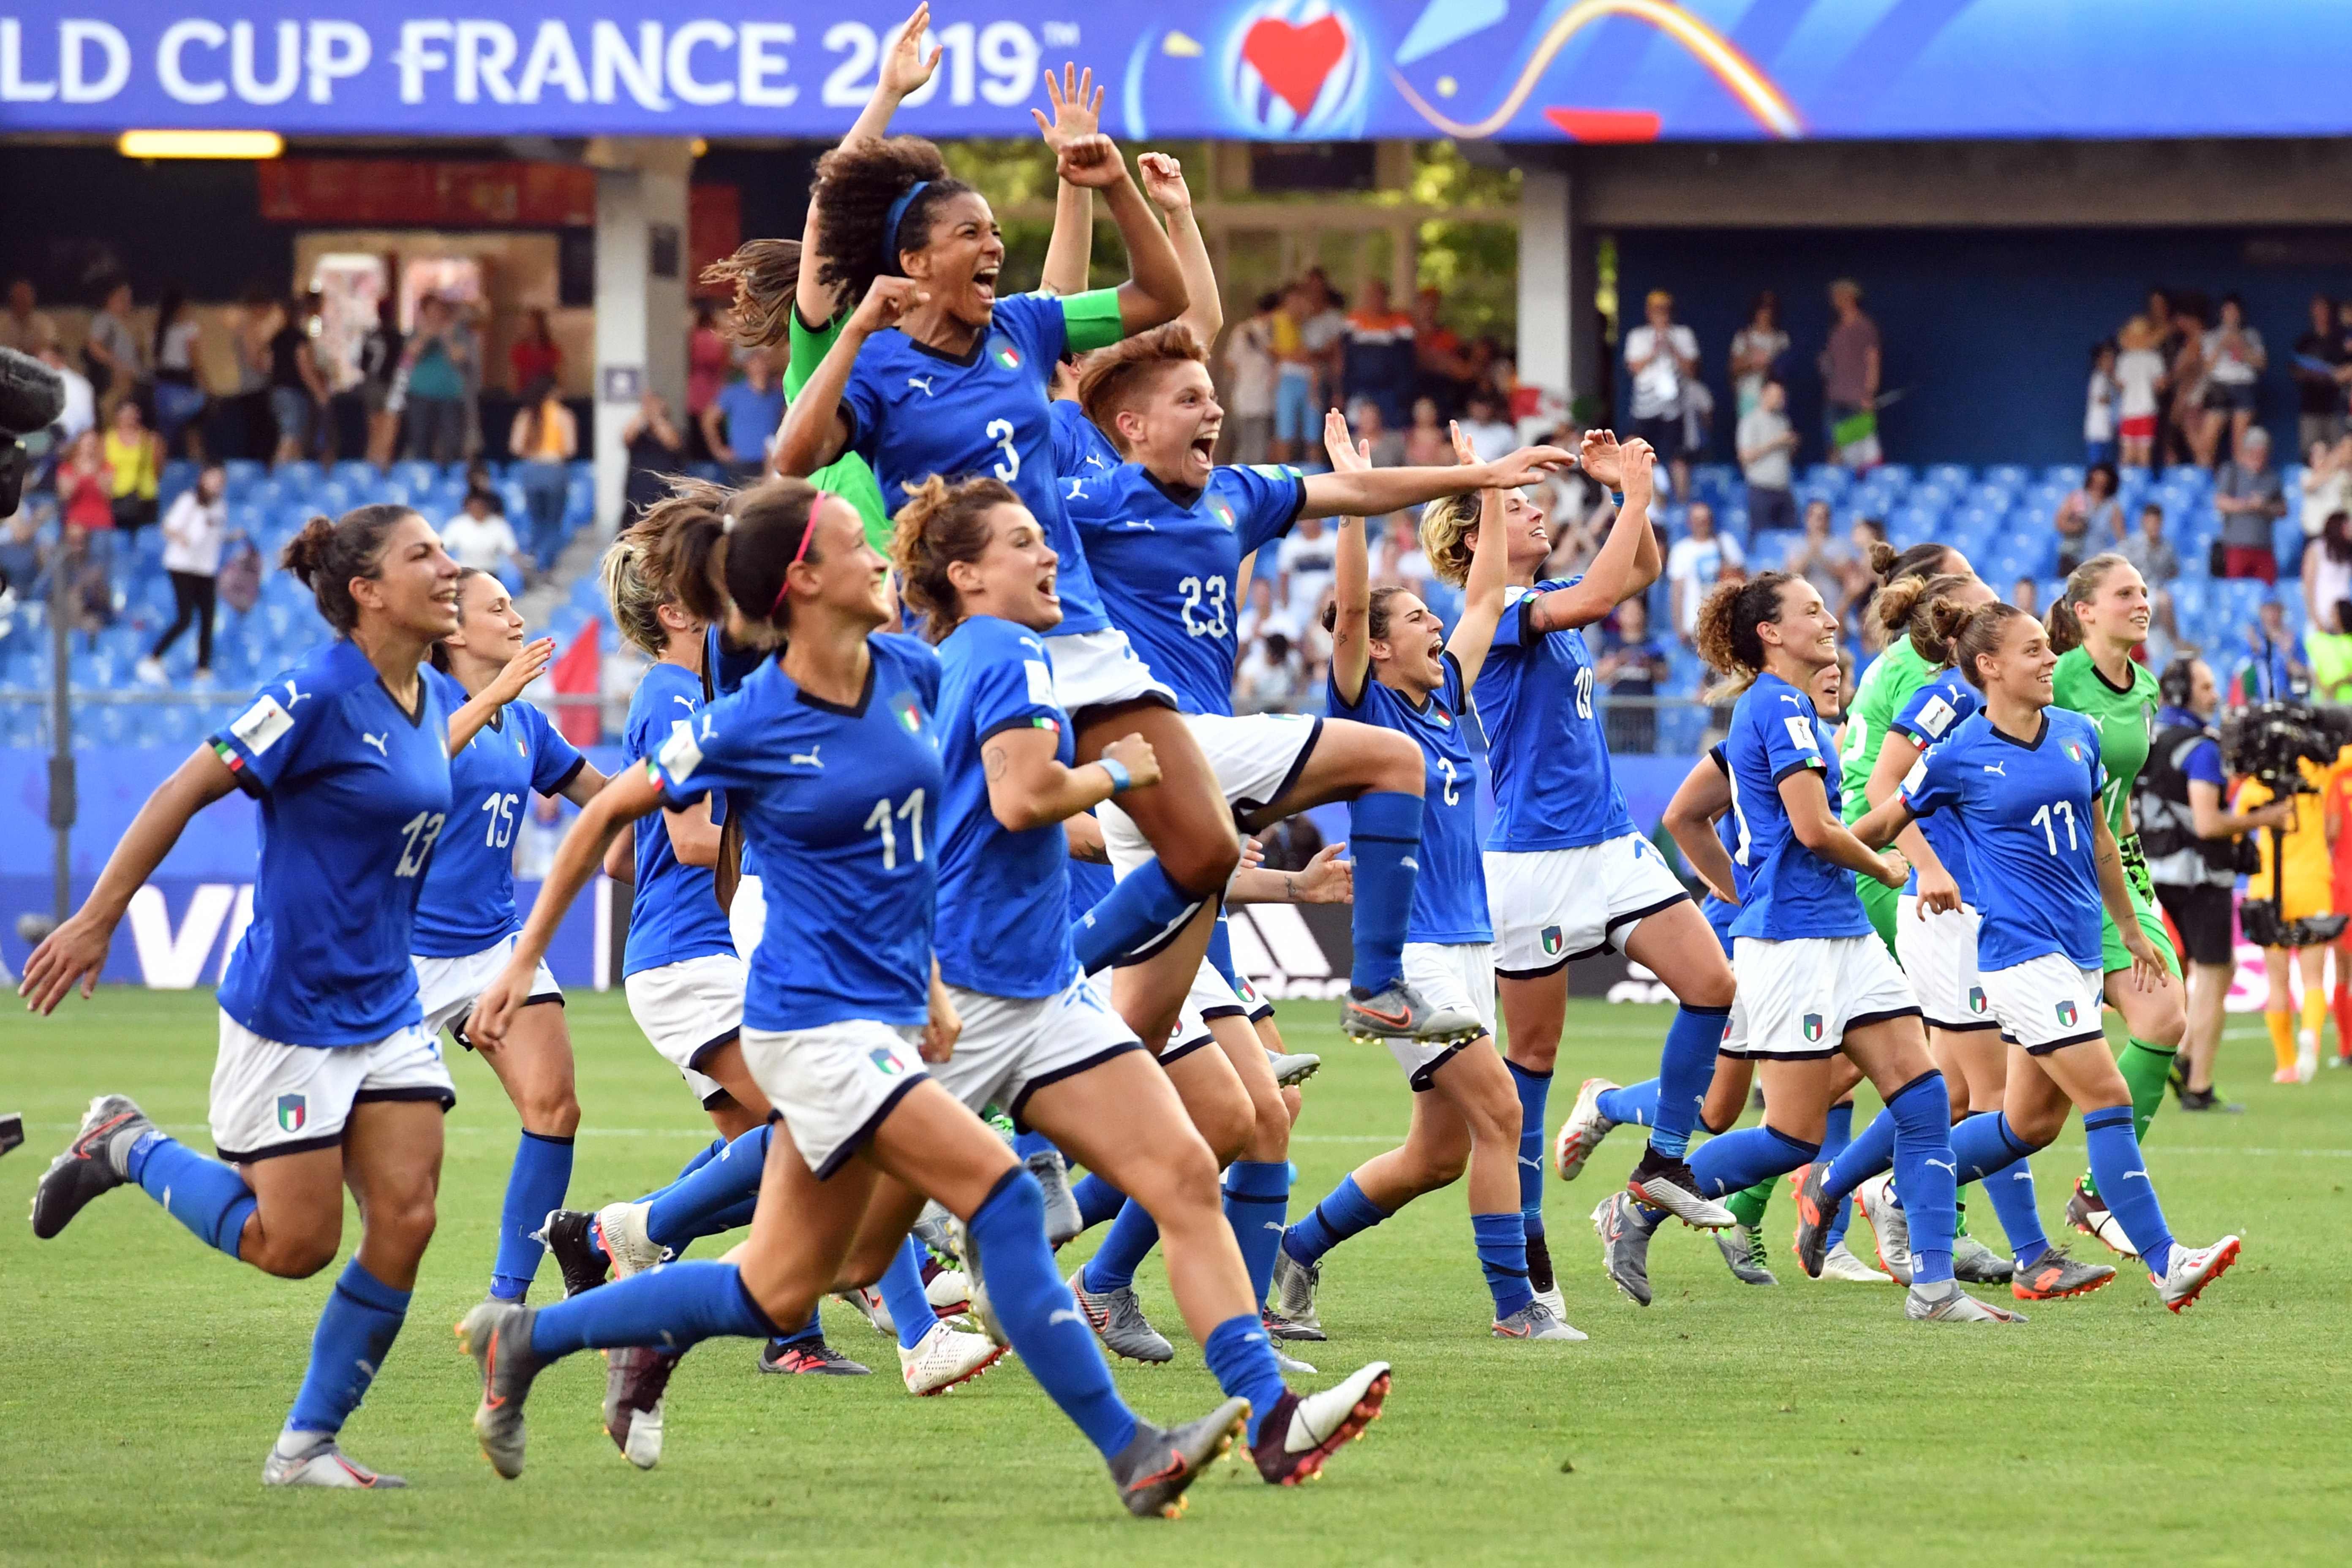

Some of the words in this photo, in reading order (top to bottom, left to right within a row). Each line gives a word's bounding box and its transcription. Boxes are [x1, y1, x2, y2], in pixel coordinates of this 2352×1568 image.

[156, 19, 372, 105] CUP
[391, 19, 799, 112] FRANCE
[986, 418, 1020, 482] 3
[1178, 574, 1228, 639] 23
[1573, 666, 1593, 720] 19
[1437, 756, 1459, 806] 2
[2105, 778, 2122, 824] 1
[395, 811, 446, 878] 13
[482, 792, 519, 849] 15
[863, 787, 926, 871] 11
[2031, 800, 2077, 856] 17
